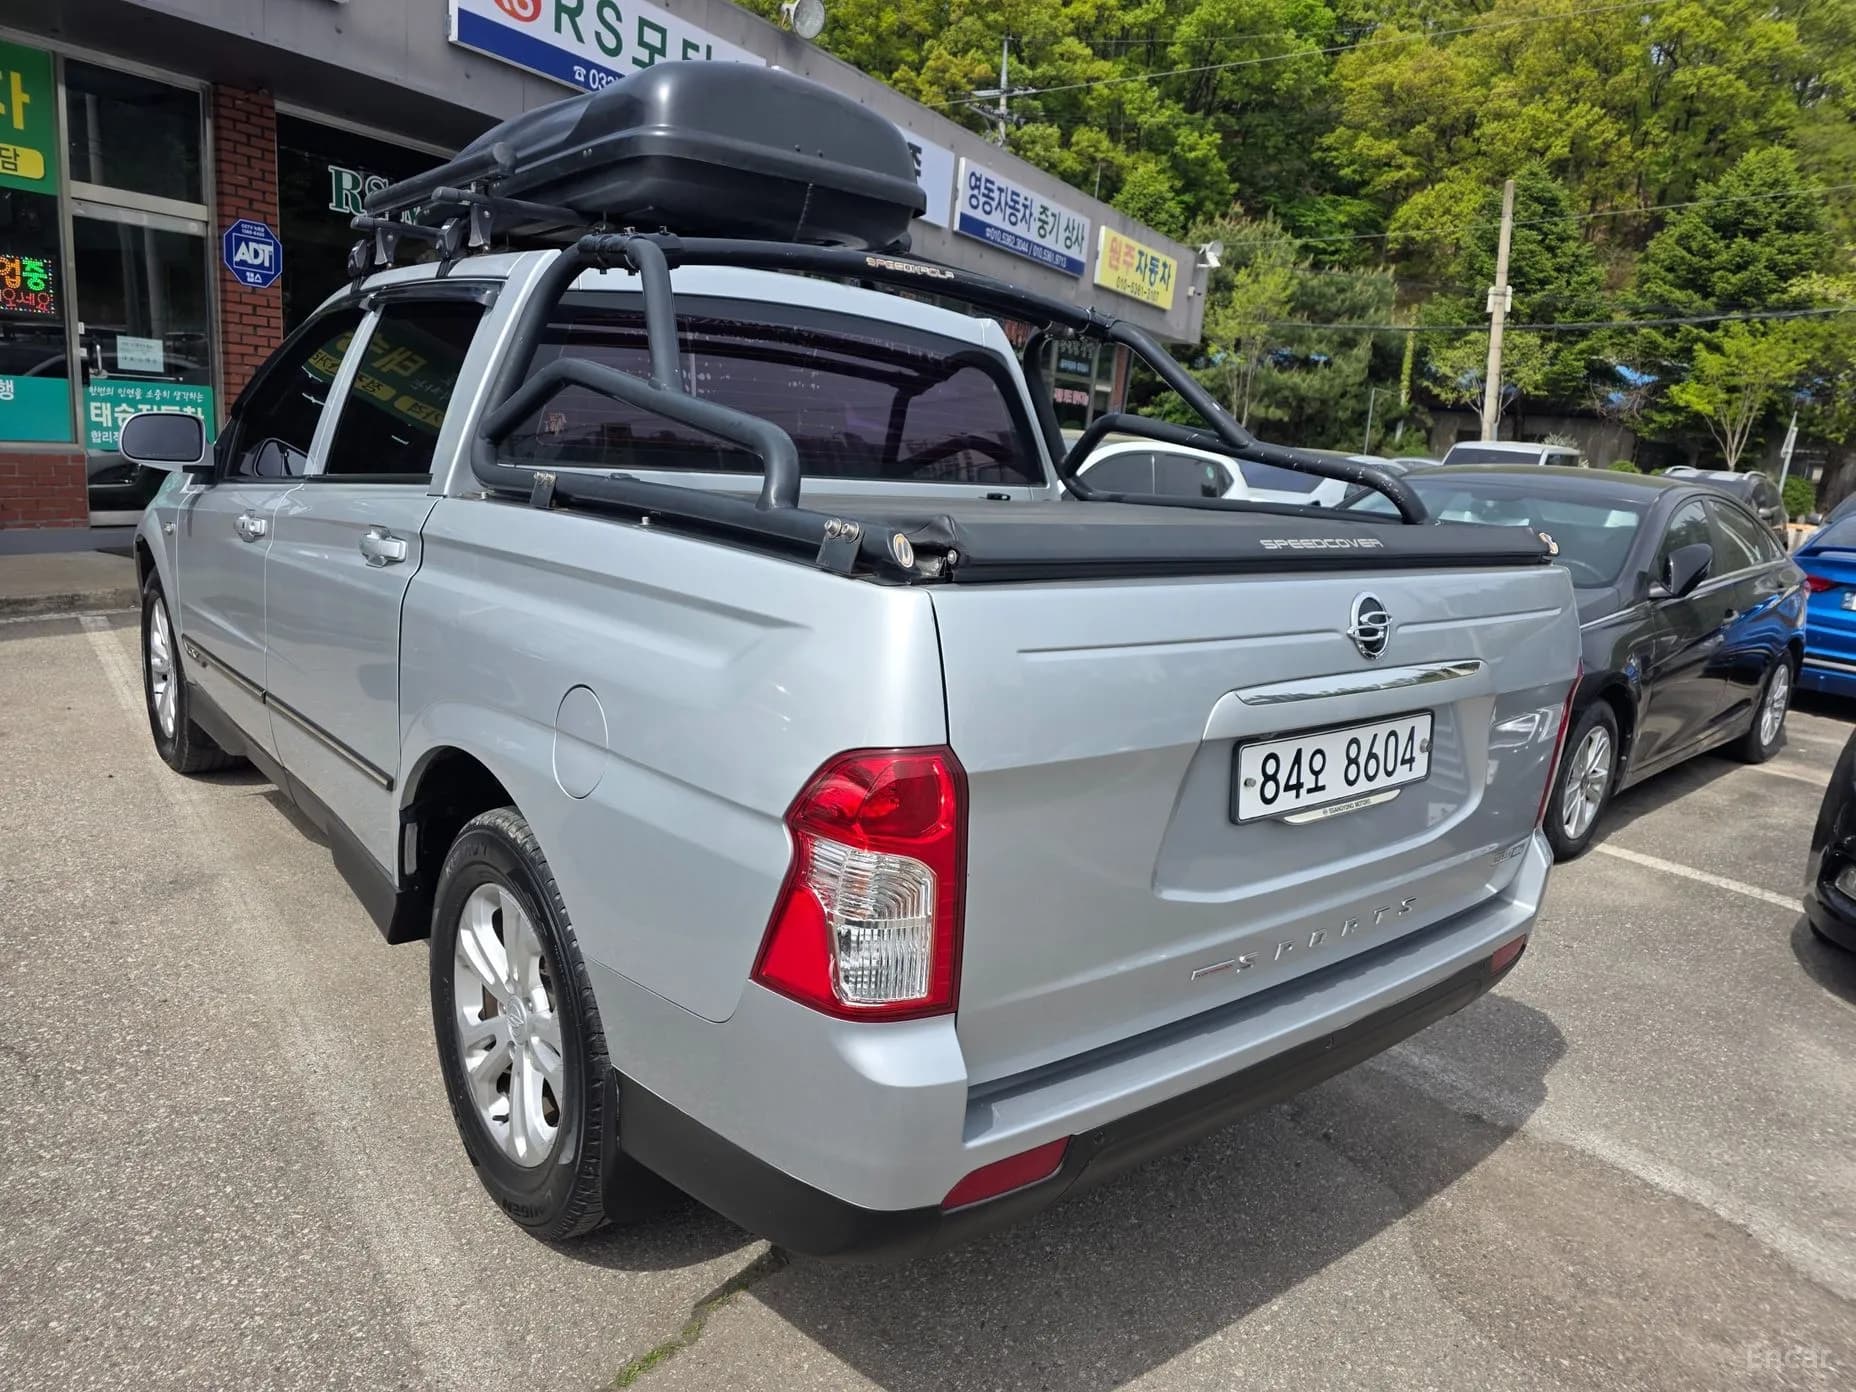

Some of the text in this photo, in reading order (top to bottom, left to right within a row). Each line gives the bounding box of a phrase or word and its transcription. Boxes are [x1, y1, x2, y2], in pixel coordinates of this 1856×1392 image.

[235, 241, 273, 268] ADT
[1064, 216, 1085, 255] 상사
[1136, 249, 1171, 292] 자동차
[89, 386, 205, 403] 한번의 인연을 소중히 생각하는
[1259, 538, 1384, 549] SPEEDCOVER
[1259, 725, 1416, 806] 84오 8604
[1236, 897, 1417, 977] SPORTS
